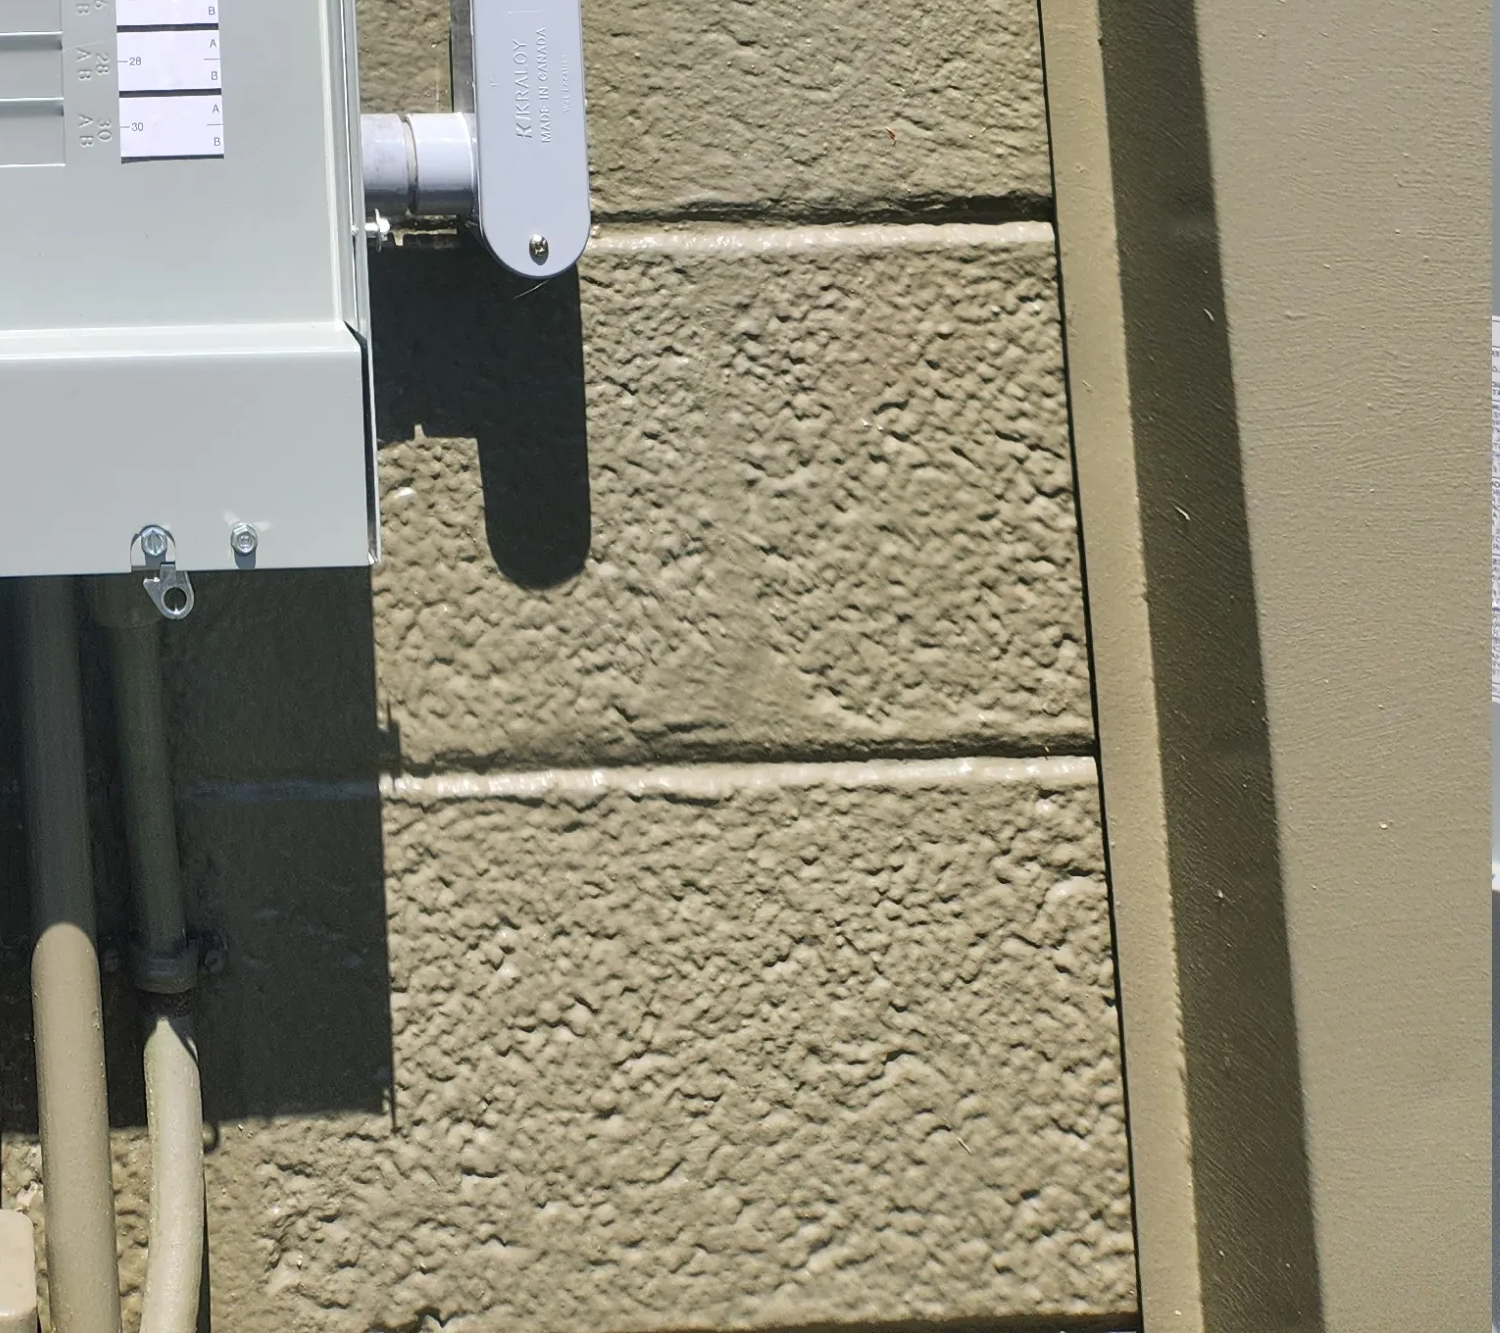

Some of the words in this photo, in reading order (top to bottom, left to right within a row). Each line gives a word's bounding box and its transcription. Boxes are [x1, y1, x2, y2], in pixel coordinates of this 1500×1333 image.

[129, 57, 142, 66] 28
[536, 27, 548, 82] CANADA
[539, 86, 549, 100] IN
[131, 122, 144, 131] 30
[540, 104, 551, 143] MADE
